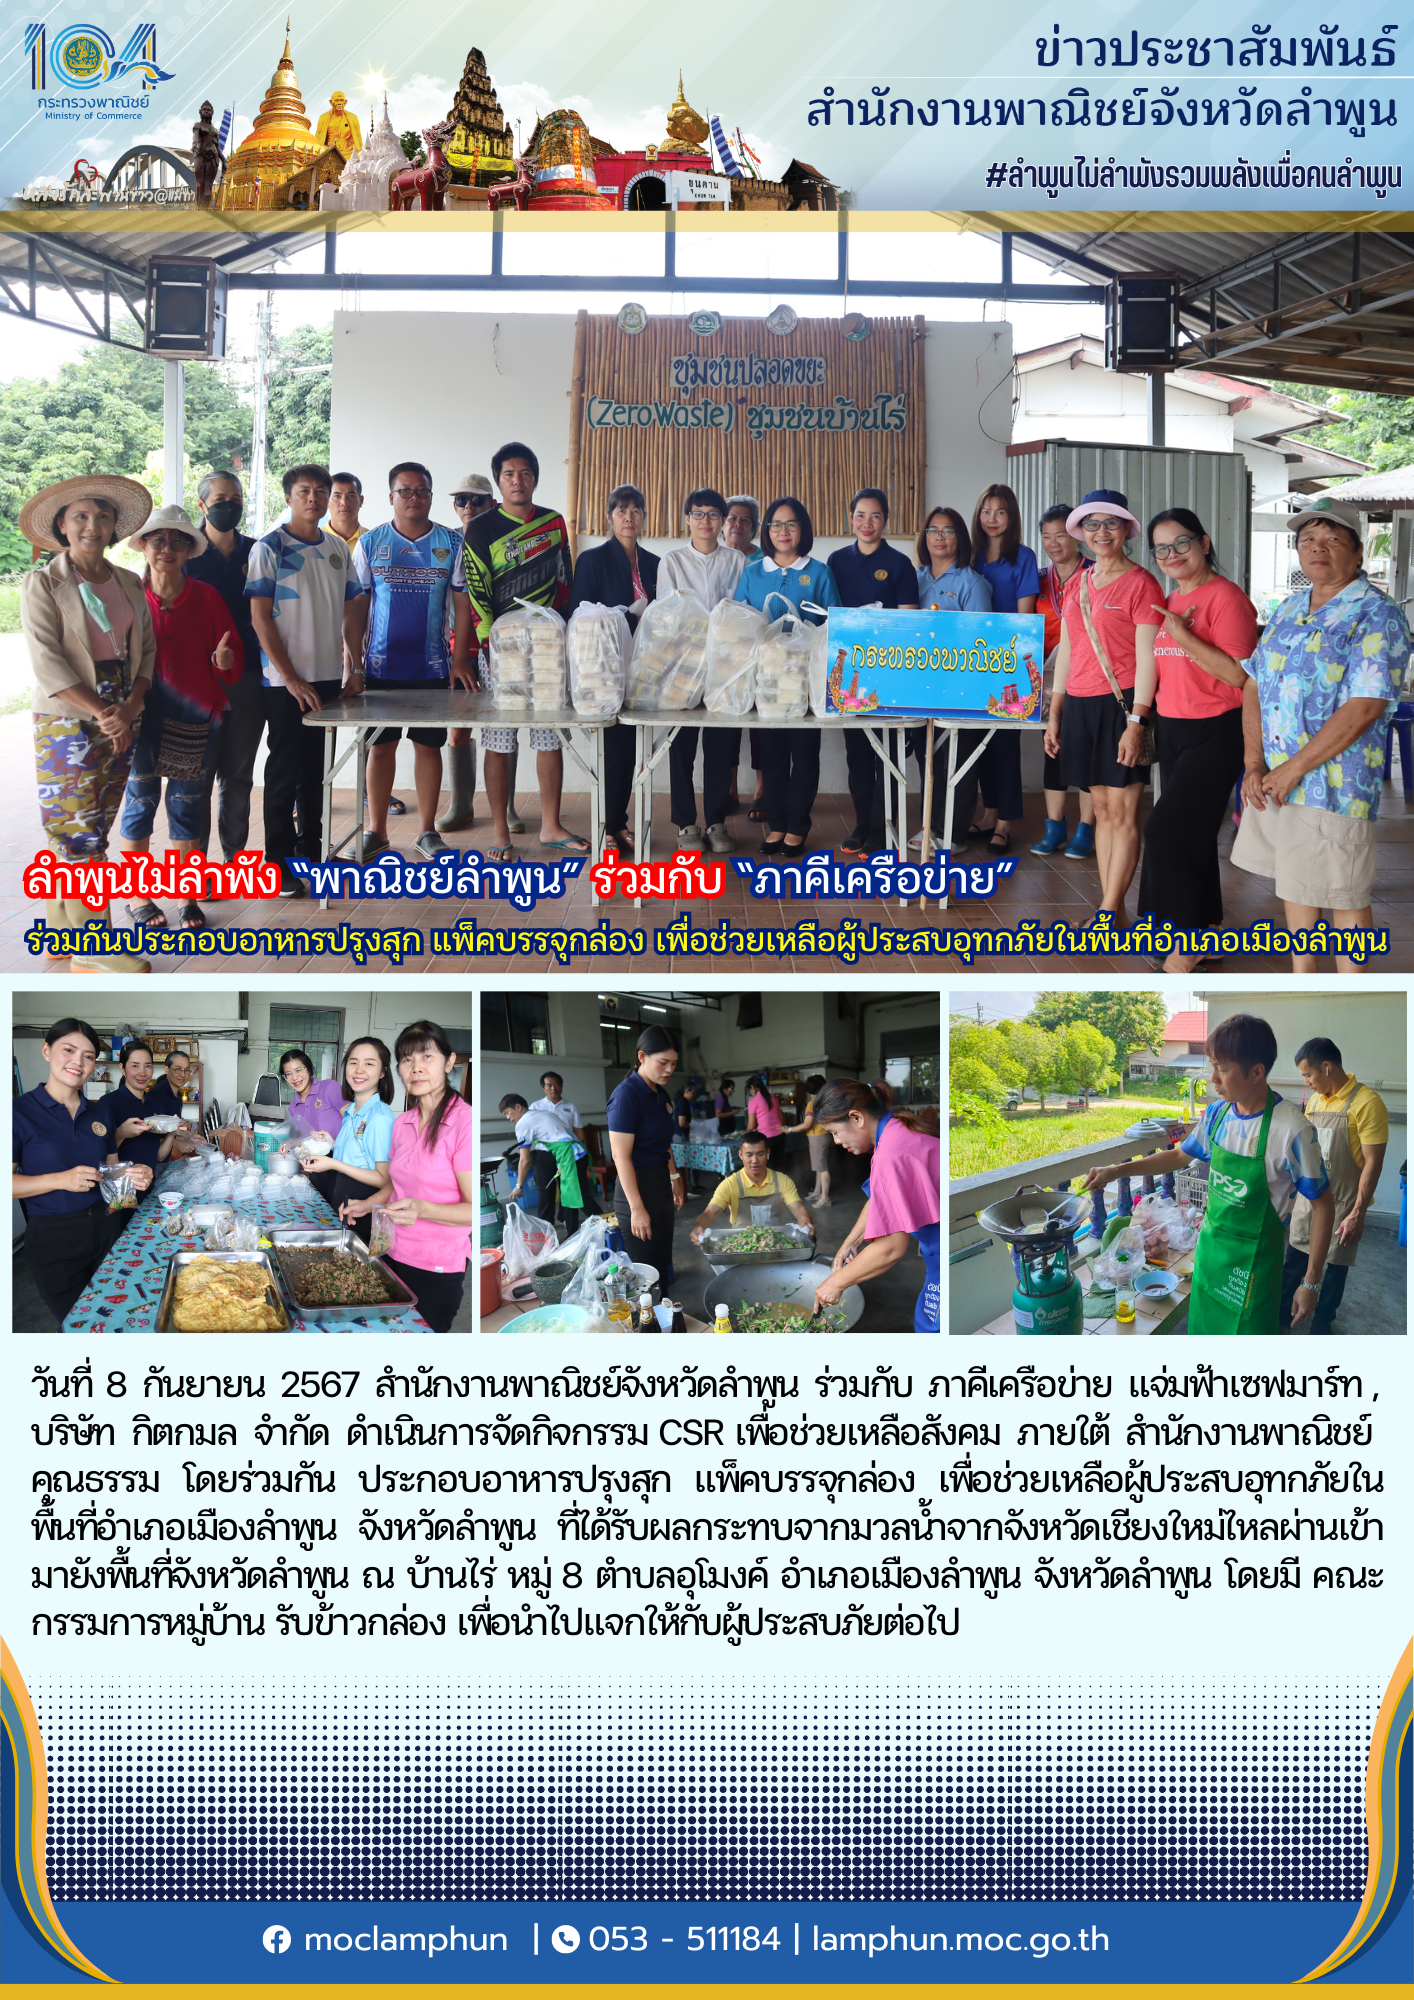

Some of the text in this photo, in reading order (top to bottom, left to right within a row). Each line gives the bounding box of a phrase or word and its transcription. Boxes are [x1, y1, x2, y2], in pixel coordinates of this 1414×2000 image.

[673, 352, 825, 397] ชุมชนปลอดขยะ
[747, 394, 906, 439] ชุมชนบ้านไร่
[851, 634, 1018, 673] กระทรวงพาณิชย์
